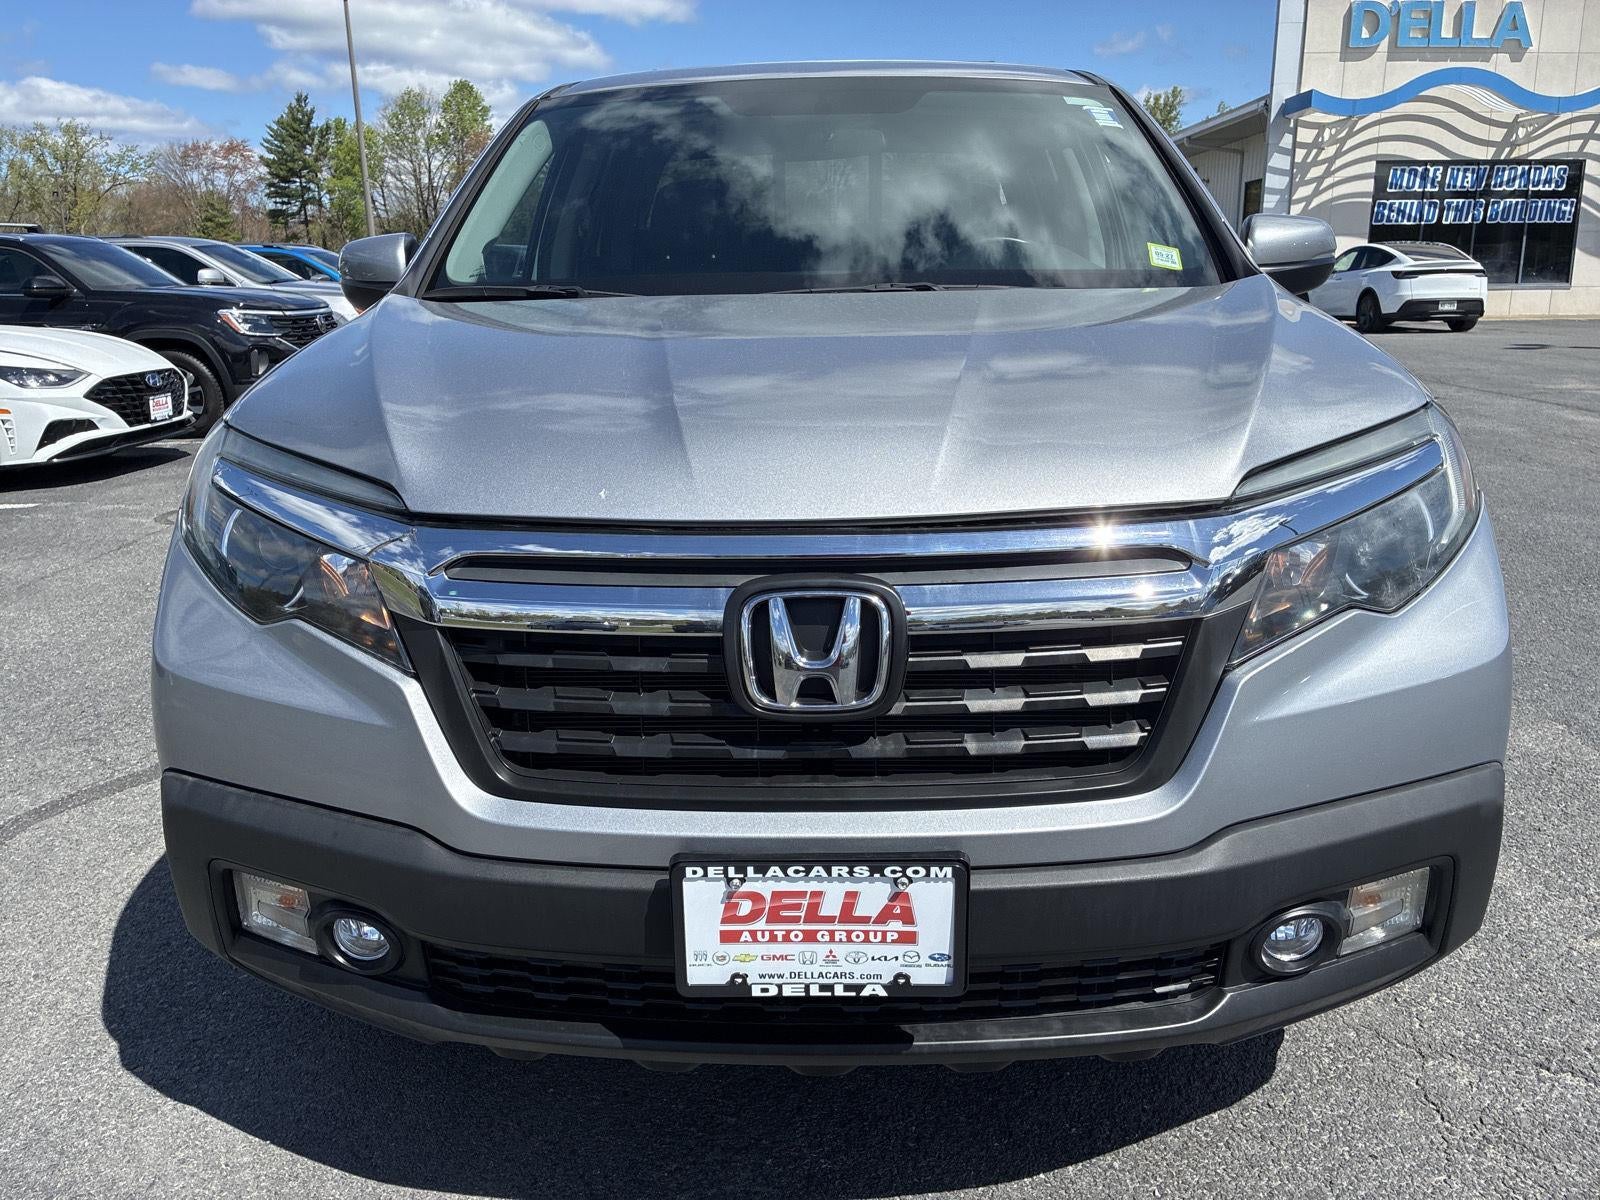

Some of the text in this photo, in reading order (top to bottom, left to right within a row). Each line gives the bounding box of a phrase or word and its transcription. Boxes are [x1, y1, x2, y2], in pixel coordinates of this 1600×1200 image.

[1349, 0, 1533, 49] D'ELLA
[1386, 165, 1569, 192] MORE NEW HONDAS
[1372, 199, 1577, 226] BEHIND THIS BUILDING!
[685, 865, 952, 878] DELLACARS.COM
[720, 890, 918, 927] DELLA
[739, 930, 899, 943] AUTO GROUP
[760, 953, 796, 962] GMC
[758, 971, 883, 981] www.DELLACARS.com
[751, 984, 889, 997] DELLA
